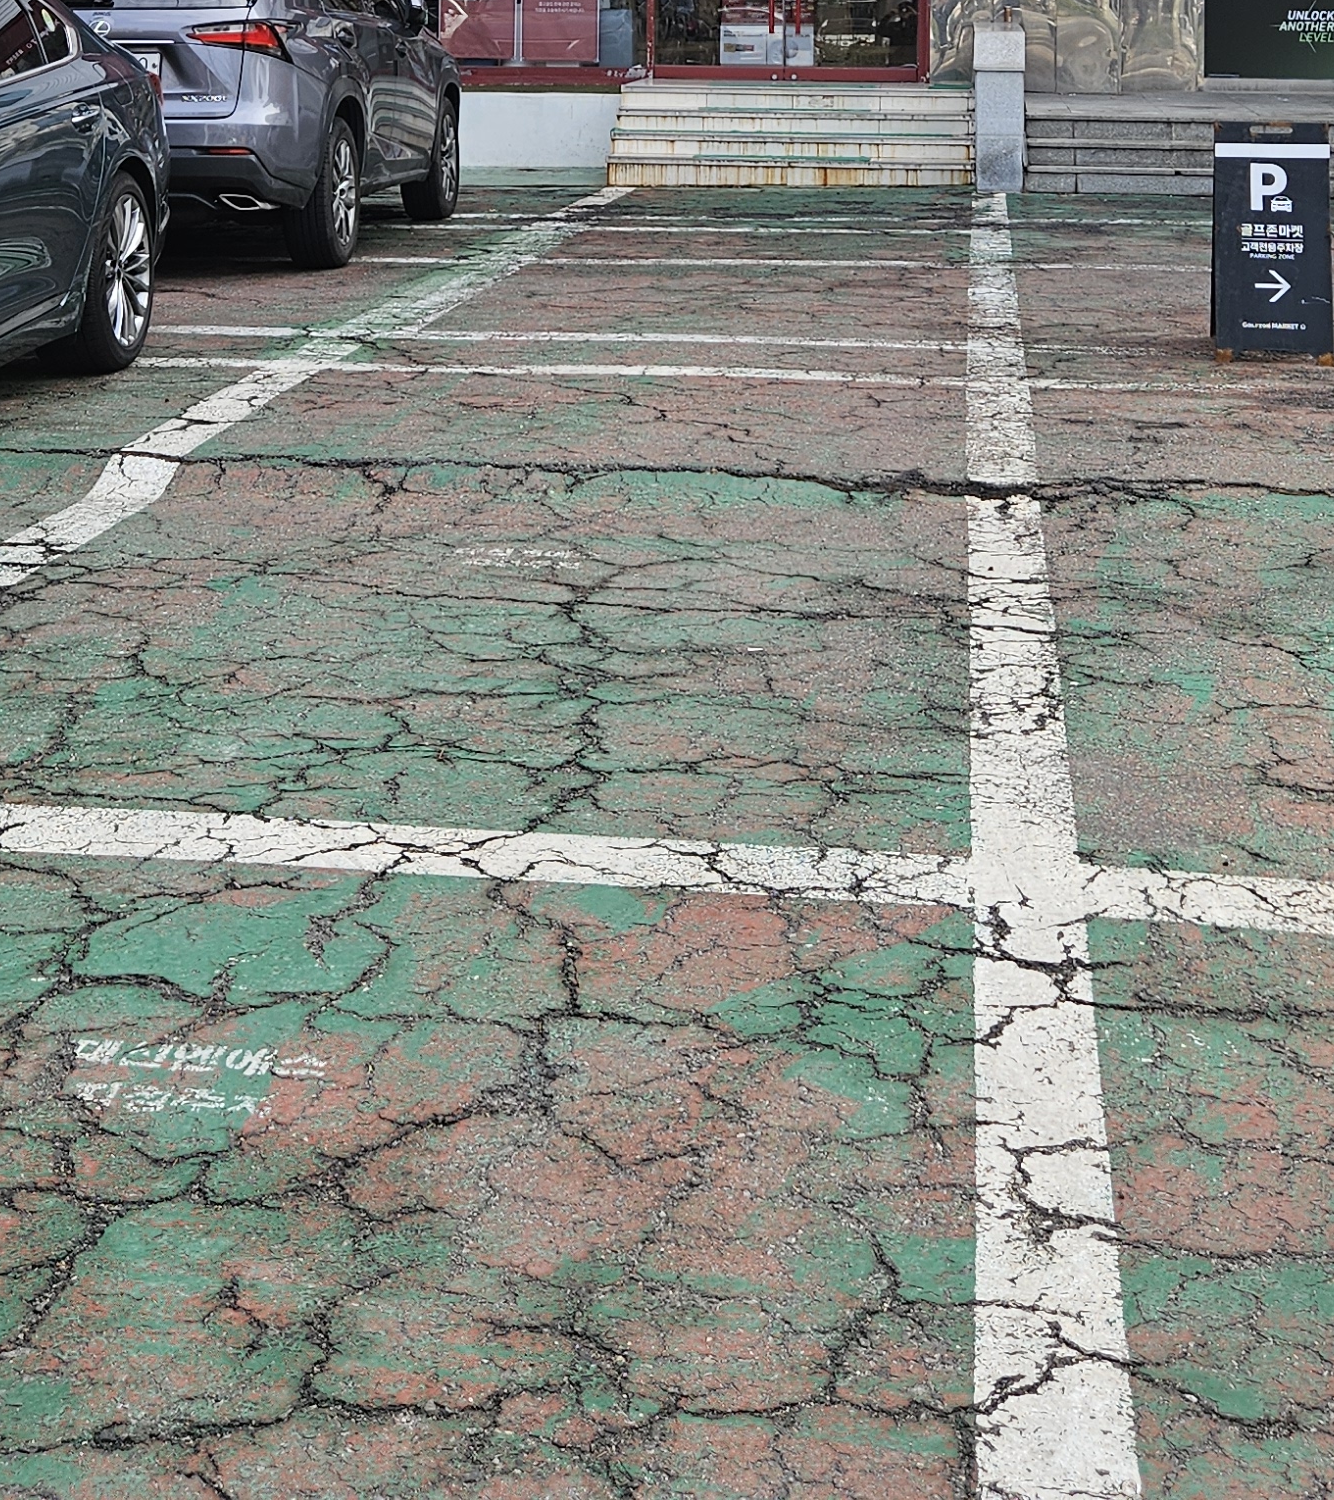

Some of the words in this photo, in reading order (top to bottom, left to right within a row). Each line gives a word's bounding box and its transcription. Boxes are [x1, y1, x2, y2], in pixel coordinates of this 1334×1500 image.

[1288, 10, 1334, 21] UNLOCK
[1279, 21, 1334, 32] ANOTHER
[1299, 32, 1334, 43] LEVEL
[1250, 163, 1287, 211] P
[1240, 223, 1304, 238] 골프존마켓
[1240, 241, 1304, 253] 고객전용주차장
[1249, 252, 1276, 260] PARKING
[1278, 252, 1295, 260] ZONE
